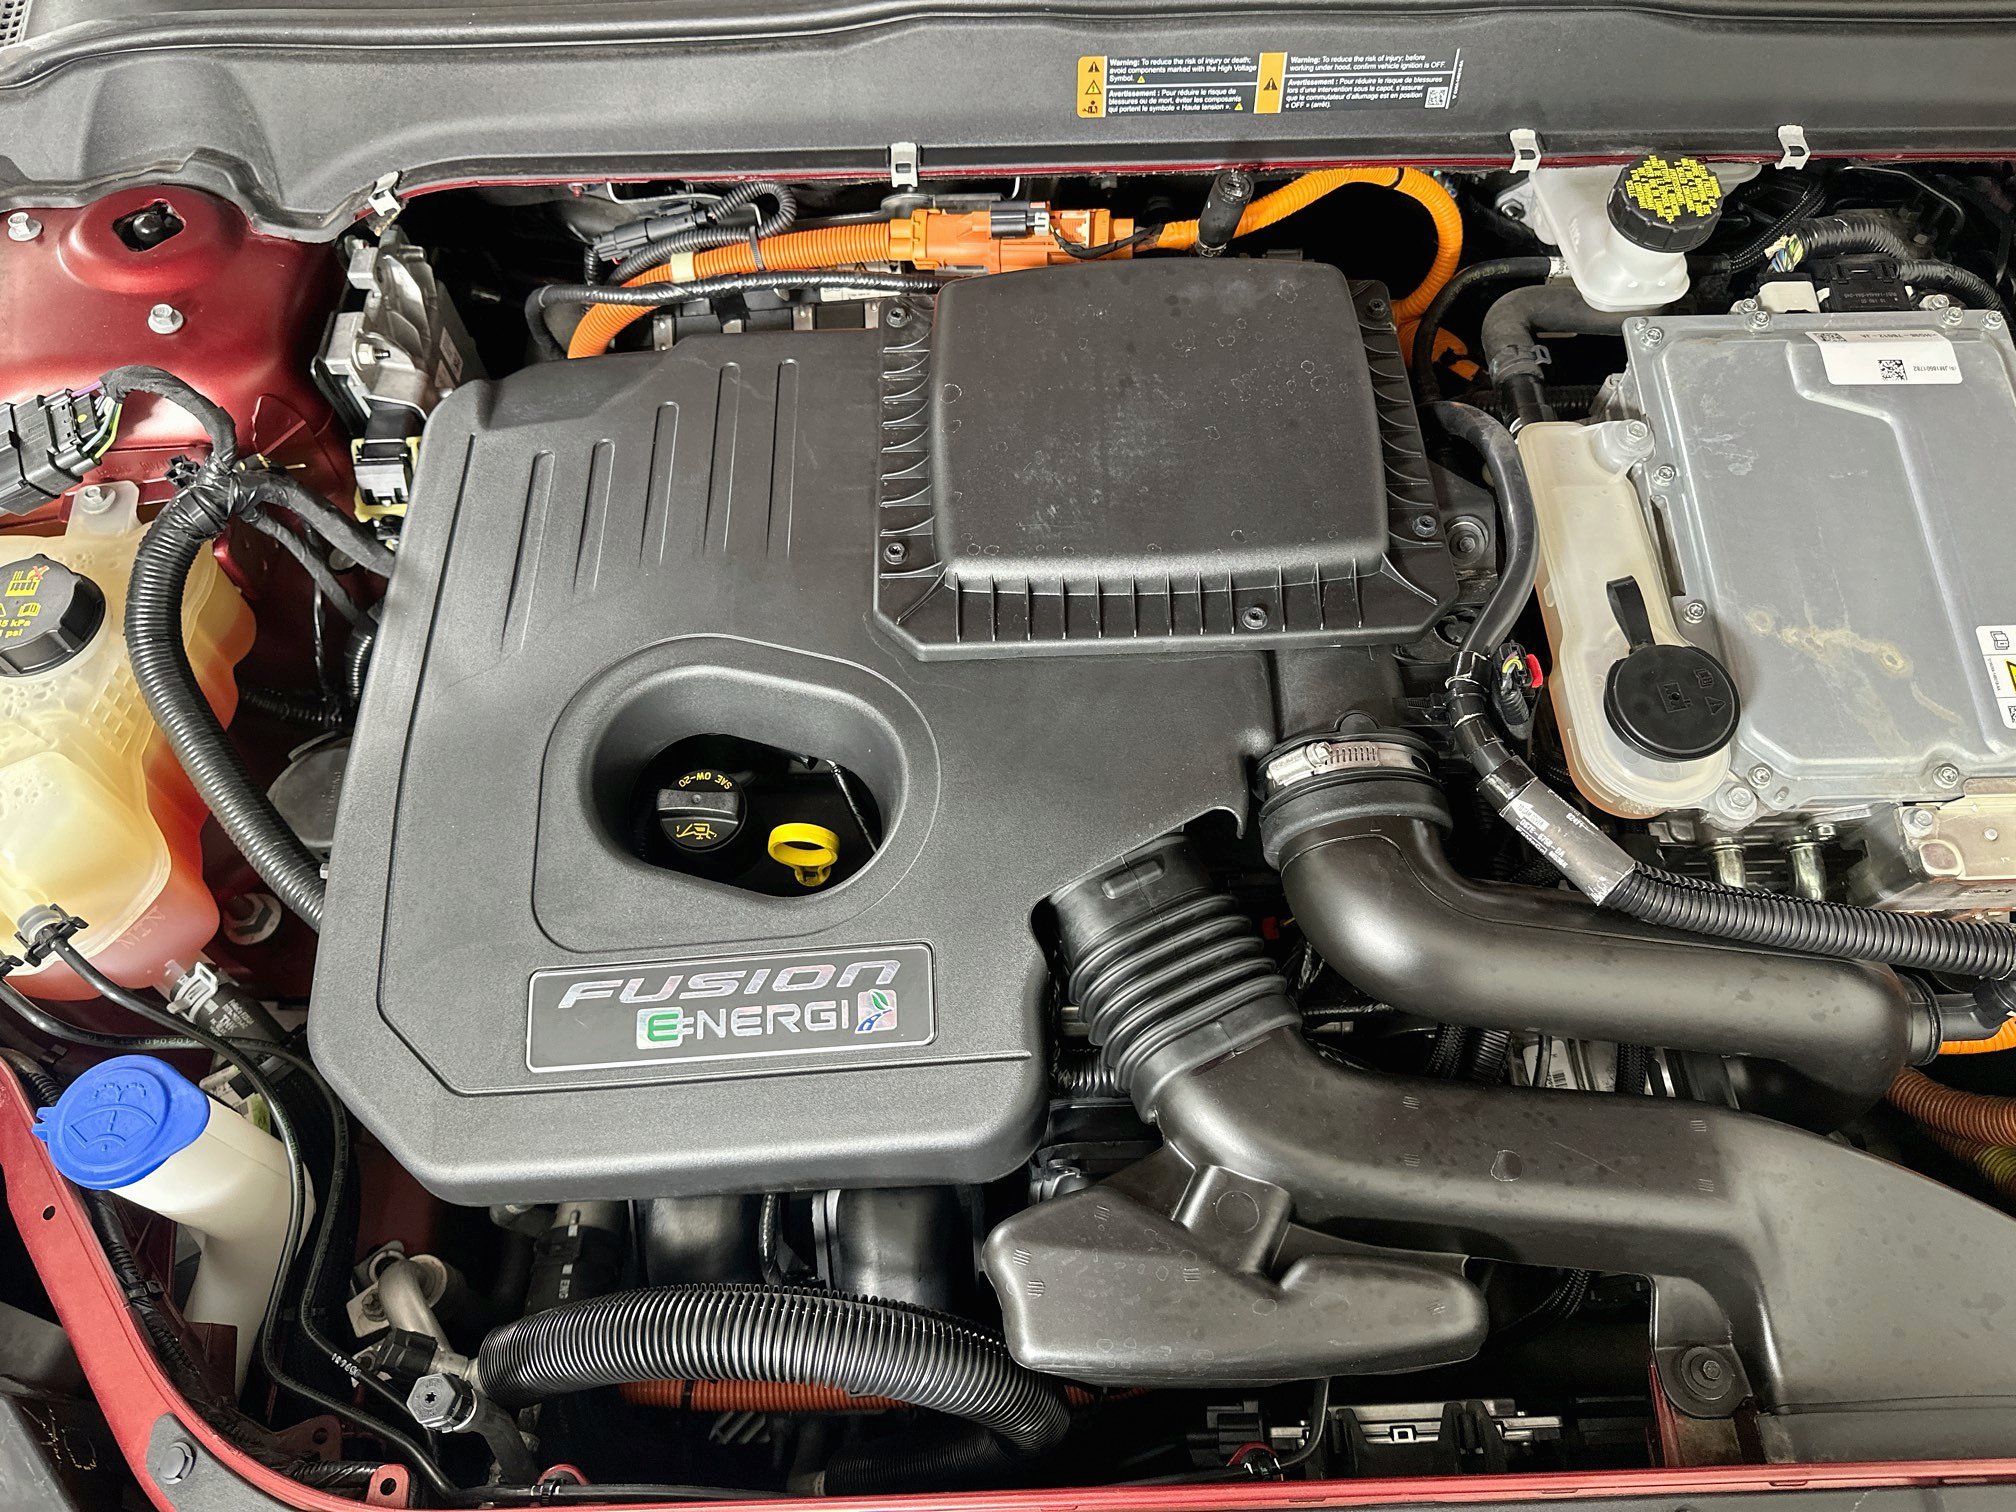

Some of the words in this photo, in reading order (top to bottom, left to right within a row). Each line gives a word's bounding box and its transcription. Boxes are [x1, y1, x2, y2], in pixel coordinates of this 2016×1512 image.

[1110, 58, 1140, 67] Warning:
[1150, 57, 1172, 65] reduce
[1173, 57, 1184, 65] the
[1197, 56, 1205, 64] of
[1205, 57, 1222, 65] injury
[1291, 56, 1321, 64] Warning:
[1365, 54, 1376, 62] risk
[1405, 53, 1426, 61] before
[1109, 66, 1127, 74] avoid
[1127, 66, 1166, 74] components
[1167, 65, 1190, 73] marked
[1206, 64, 1216, 72] the
[1217, 64, 1233, 73] High
[1233, 63, 1257, 72] Voltage
[1290, 64, 1314, 72] working
[1315, 63, 1333, 71] under
[1353, 62, 1377, 70] confirm
[1377, 61, 1400, 69] vehicle
[1400, 61, 1423, 70] ignition
[1424, 60, 1430, 68] is
[1109, 74, 1134, 83] Symbol.
[1288, 78, 1335, 86] Avertissement
[1339, 77, 1355, 85] Pour
[1384, 76, 1404, 84] risque
[1108, 89, 1156, 97] Avertissement
[1177, 88, 1199, 96] réduire
[1207, 88, 1227, 96] risque
[1318, 85, 1352, 93] intervention
[1369, 84, 1376, 92] le
[1396, 84, 1424, 92] s'assurer
[1204, 95, 1241, 103] composants
[1306, 93, 1345, 101] commutateur
[1345, 92, 1379, 101] d'allumage
[1399, 92, 1423, 100] position
[1108, 105, 1119, 113] qui
[1119, 104, 1141, 113] portent
[1149, 104, 1175, 113] symbole
[1182, 103, 1201, 111] Haute
[1291, 101, 1305, 109] OFF
[10, 619, 31, 627] kPa
[5, 628, 23, 639] psi
[714, 774, 732, 789] SAE
[558, 960, 901, 1009] FUSION
[642, 999, 850, 1045] ENERGI
